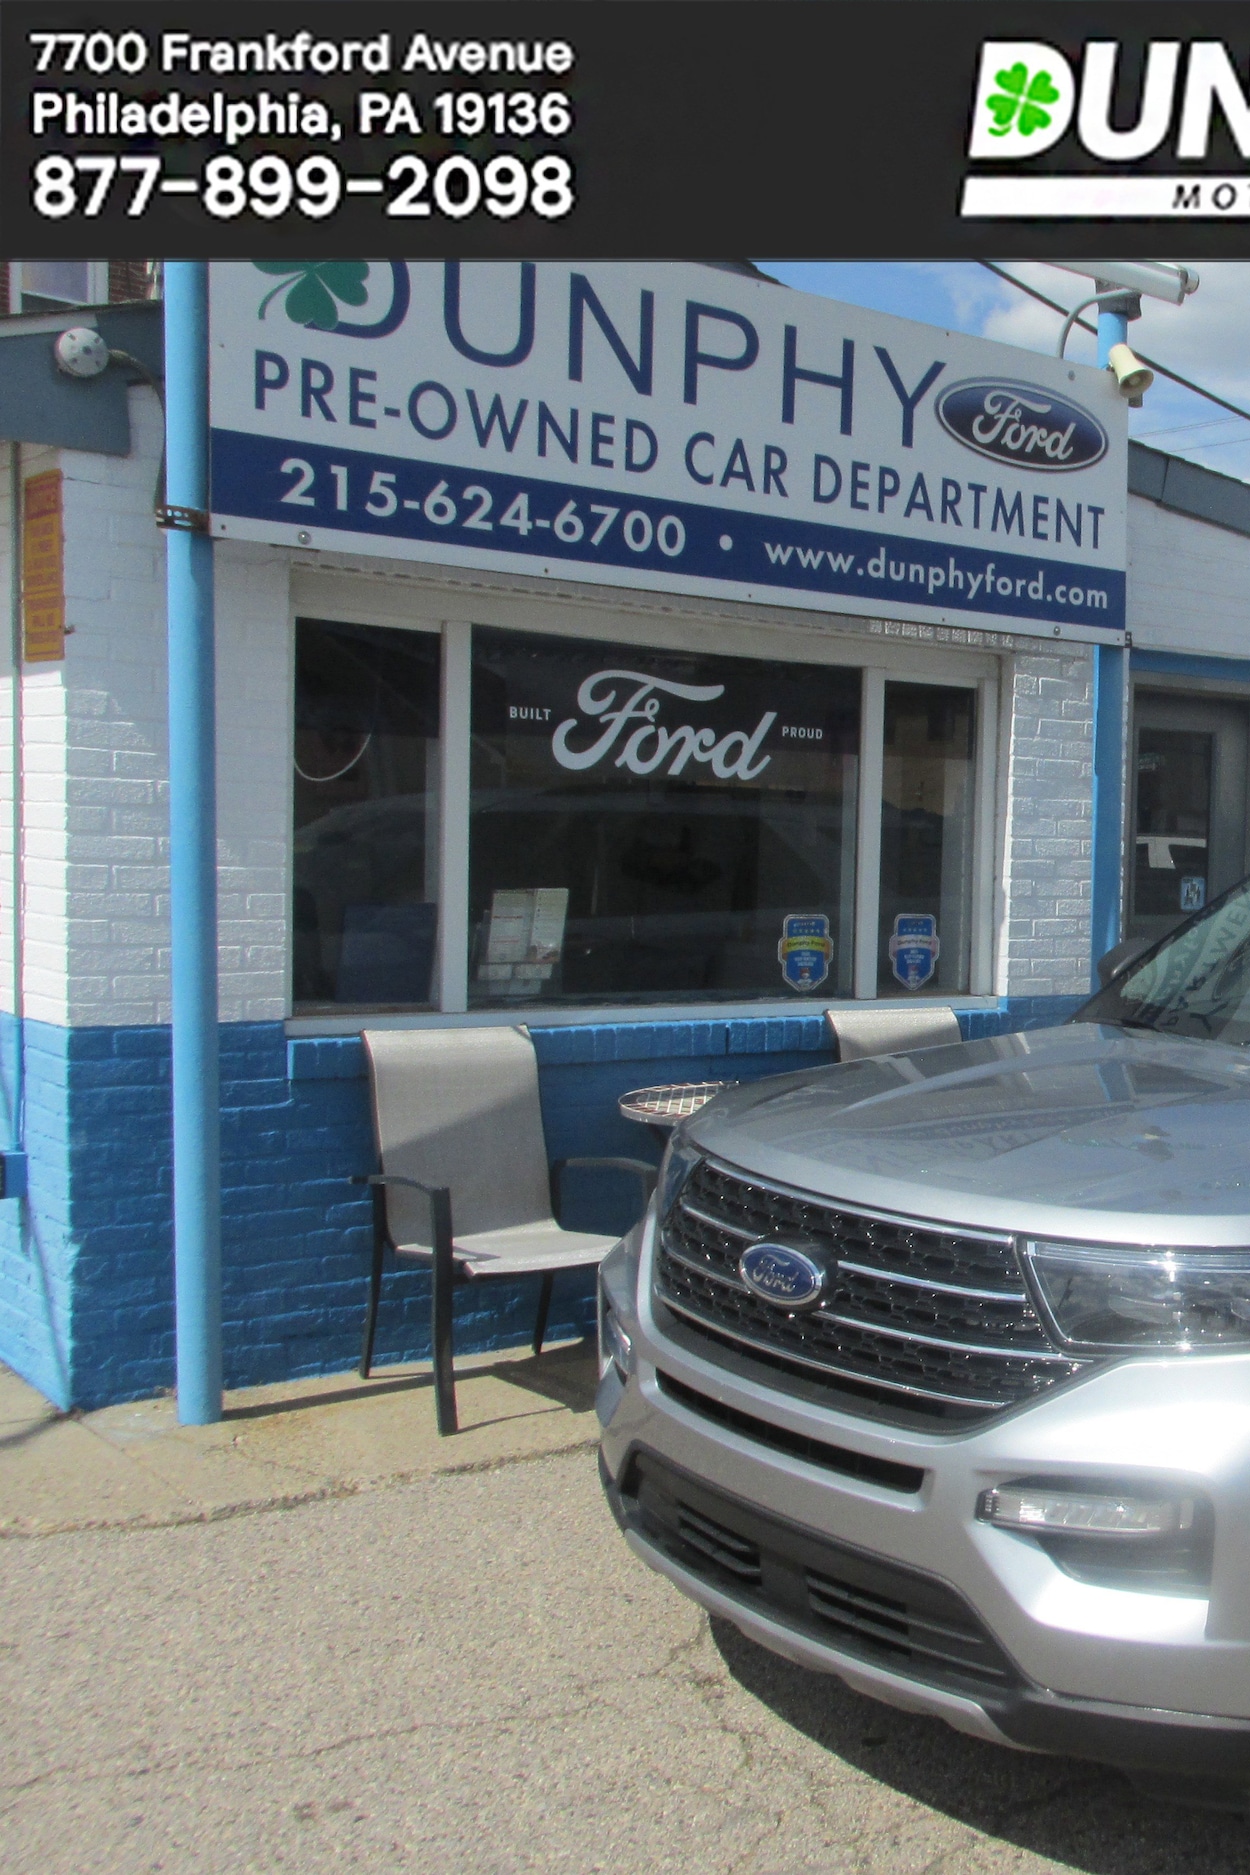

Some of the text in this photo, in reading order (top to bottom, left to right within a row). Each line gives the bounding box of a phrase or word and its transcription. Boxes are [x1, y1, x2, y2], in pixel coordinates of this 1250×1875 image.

[254, 349, 1106, 550] PRE-OWNED CAR DEPARTMENT
[971, 389, 1077, 461] Ford
[280, 457, 1109, 610] 215-624-6700 www.dunphyford.com
[509, 669, 824, 781] BUILT Ford PROUD
[752, 1253, 800, 1293] Ford
